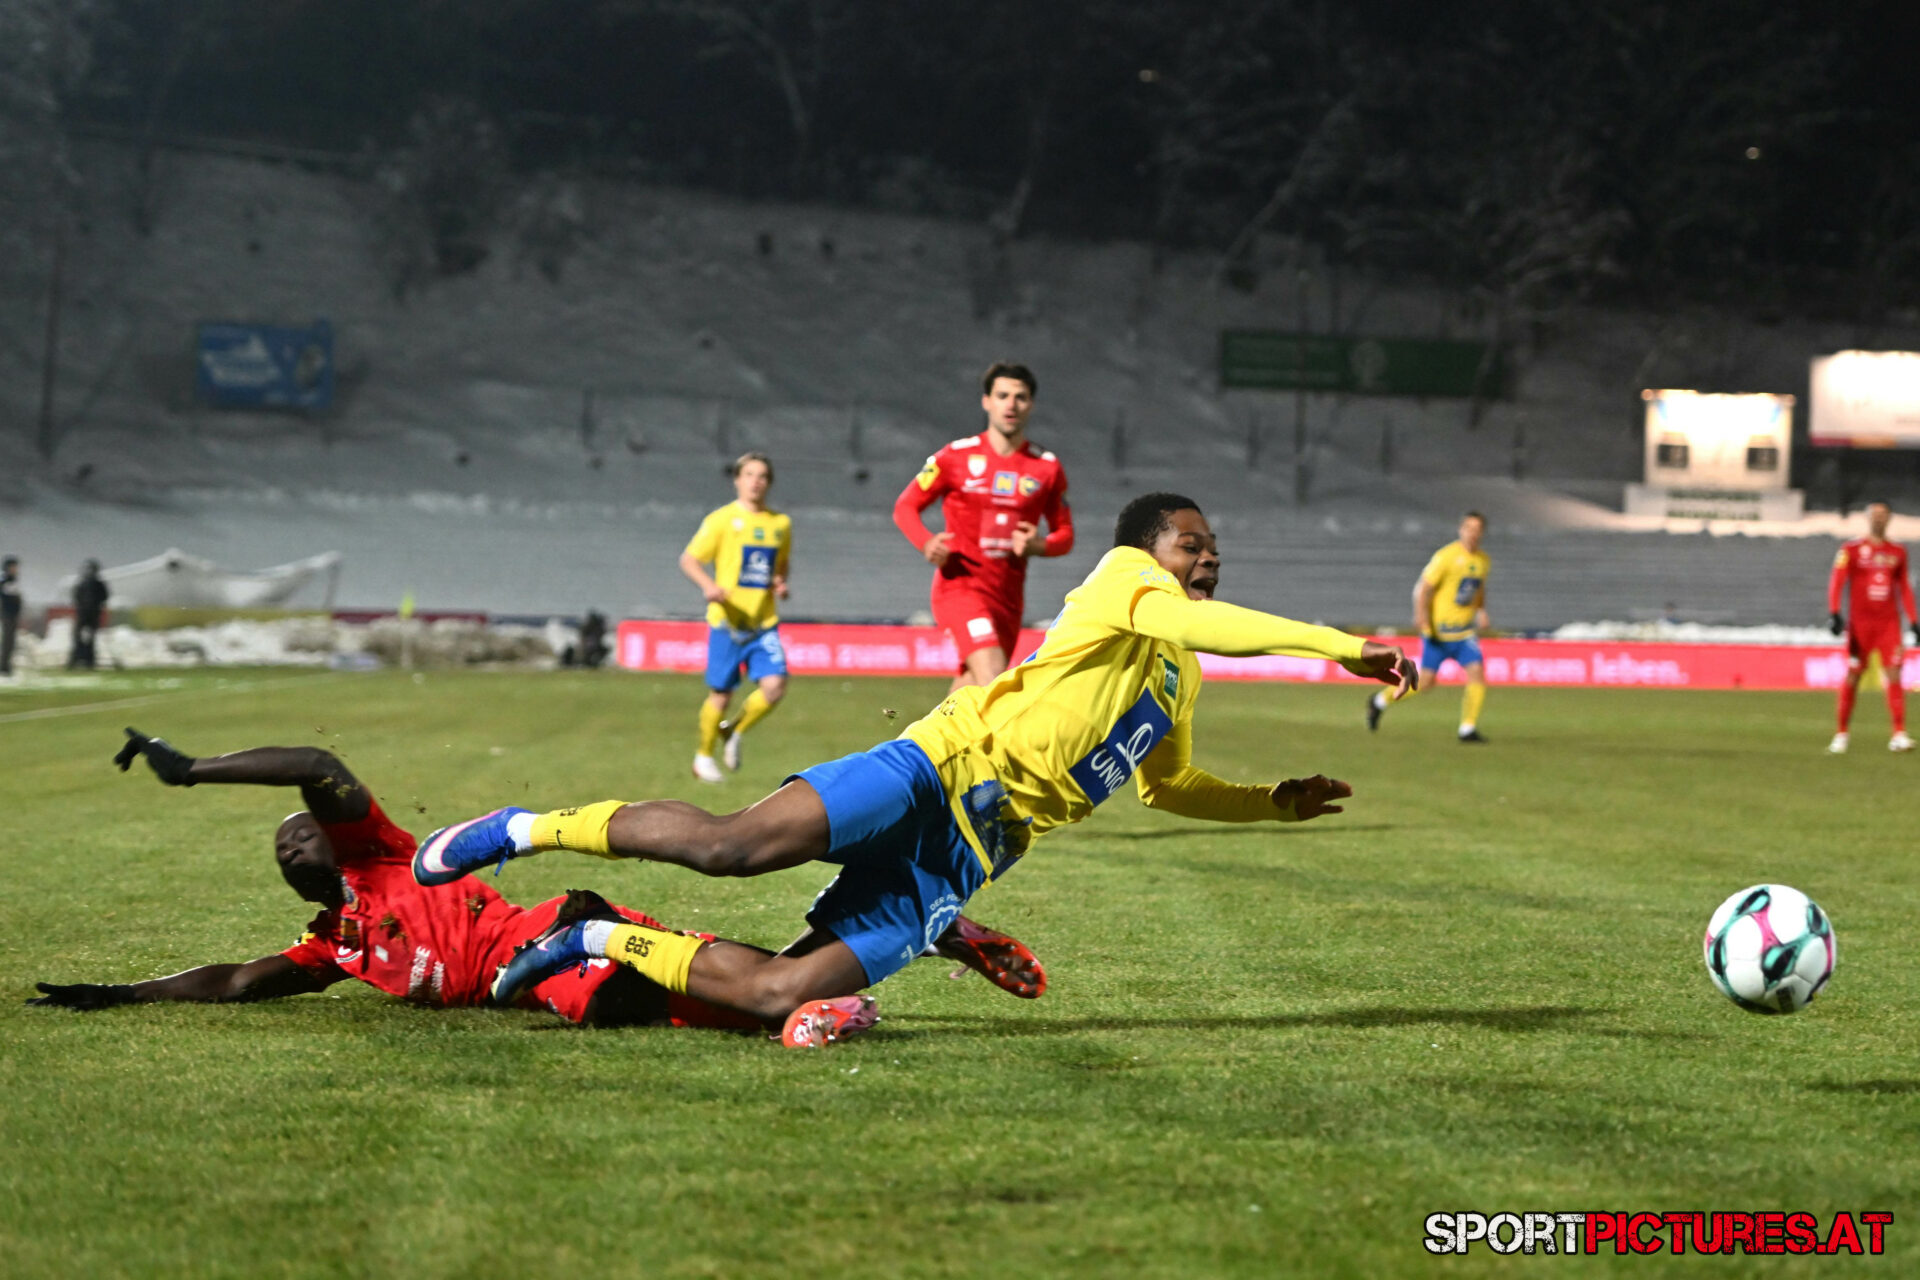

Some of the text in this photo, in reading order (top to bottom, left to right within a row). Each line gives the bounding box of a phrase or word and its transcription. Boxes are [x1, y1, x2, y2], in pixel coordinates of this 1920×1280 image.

[1515, 657, 1586, 683] zum
[1592, 651, 1690, 685] leben.
[929, 896, 945, 911] DER
